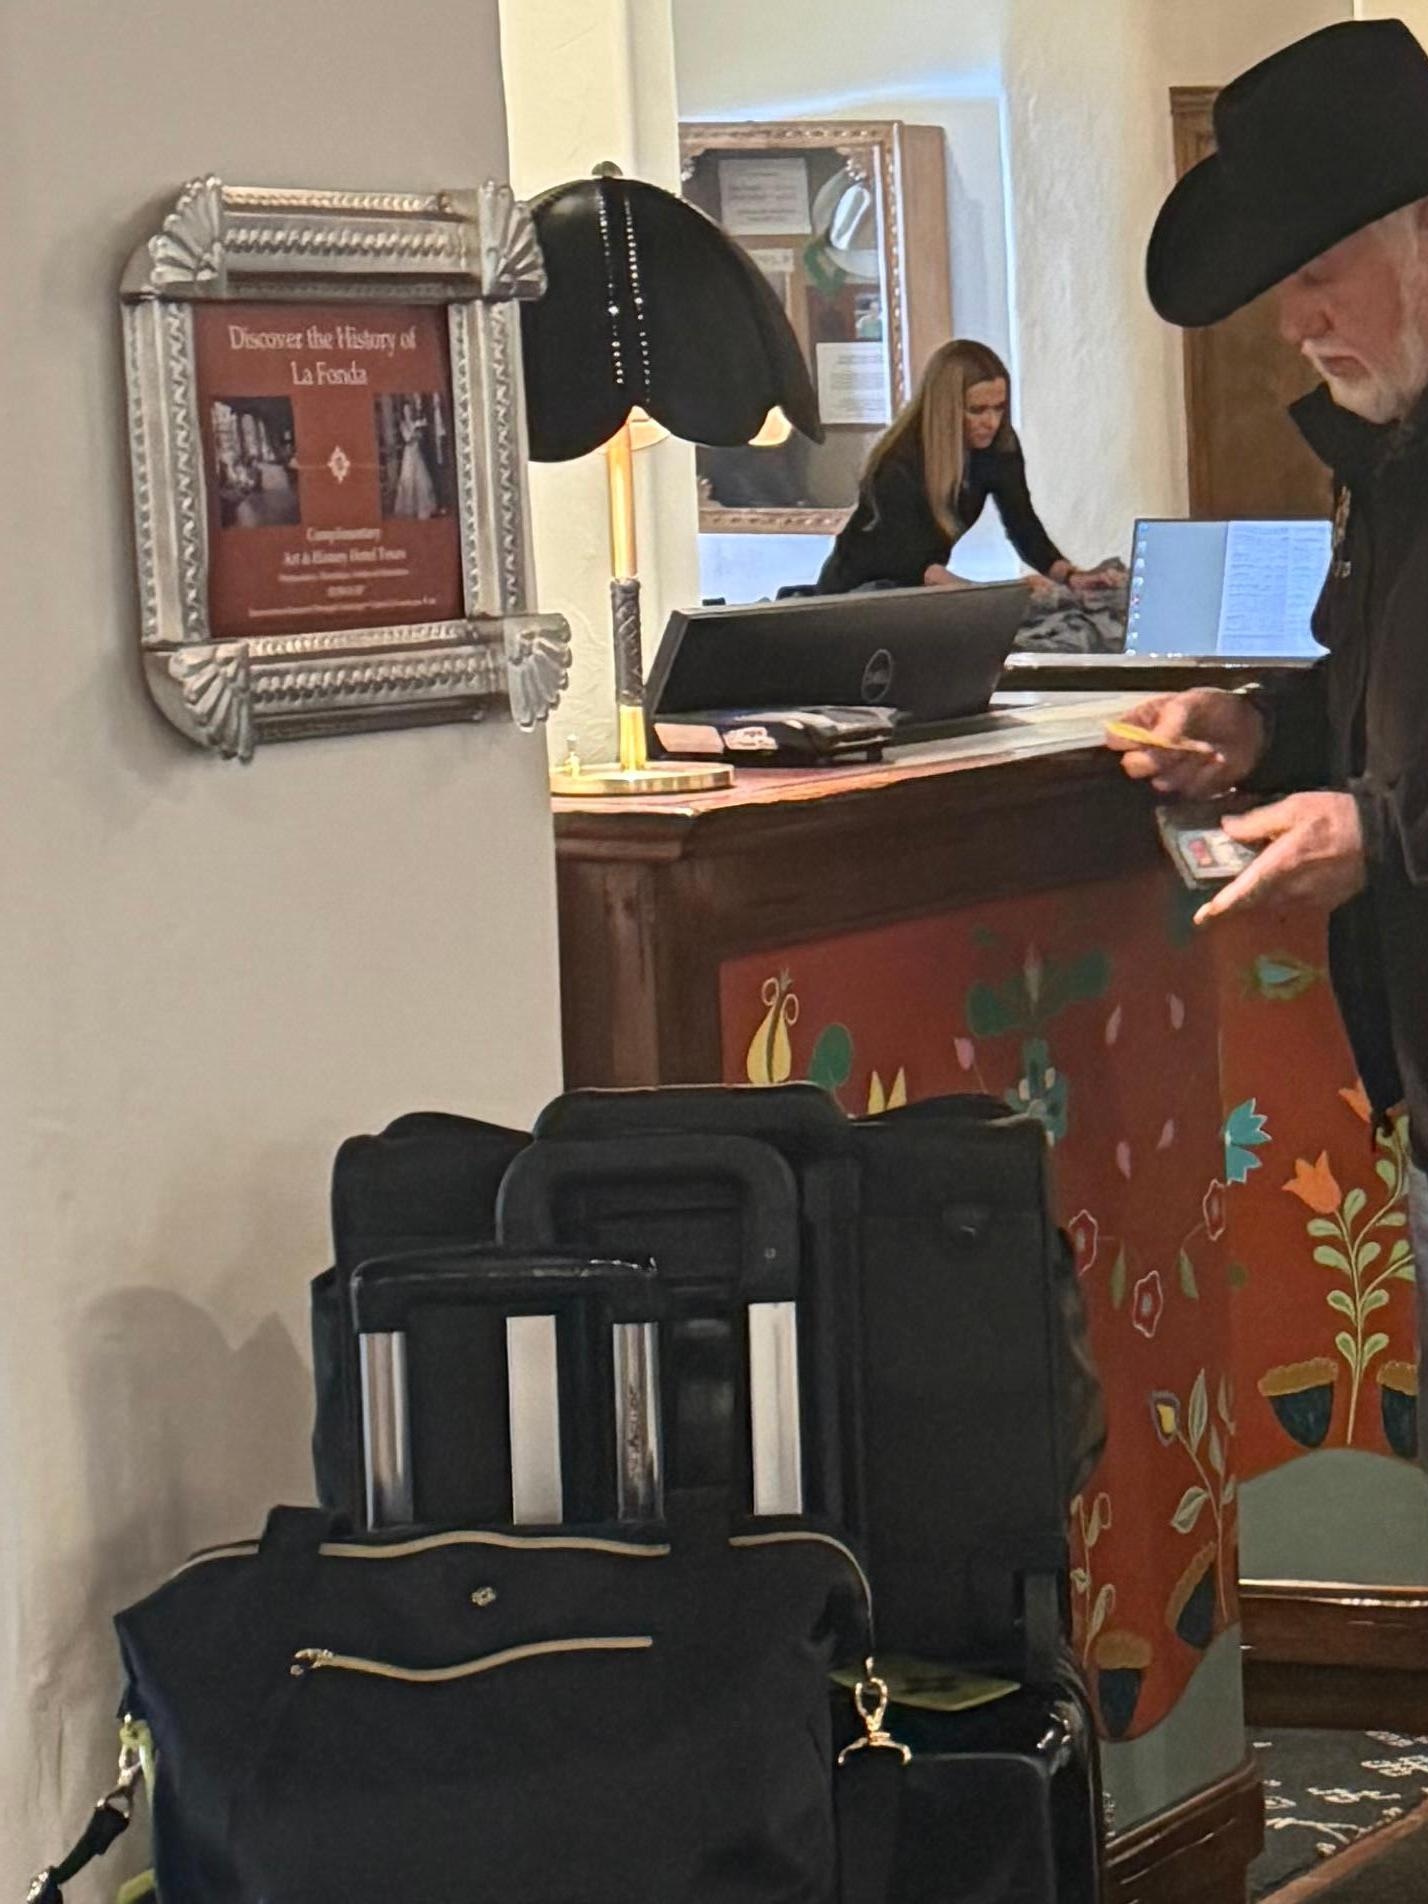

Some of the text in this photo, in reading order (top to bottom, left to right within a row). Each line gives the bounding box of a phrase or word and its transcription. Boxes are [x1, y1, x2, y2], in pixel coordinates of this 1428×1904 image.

[227, 324, 417, 357] Discover the History of
[290, 360, 368, 385] La Fonda
